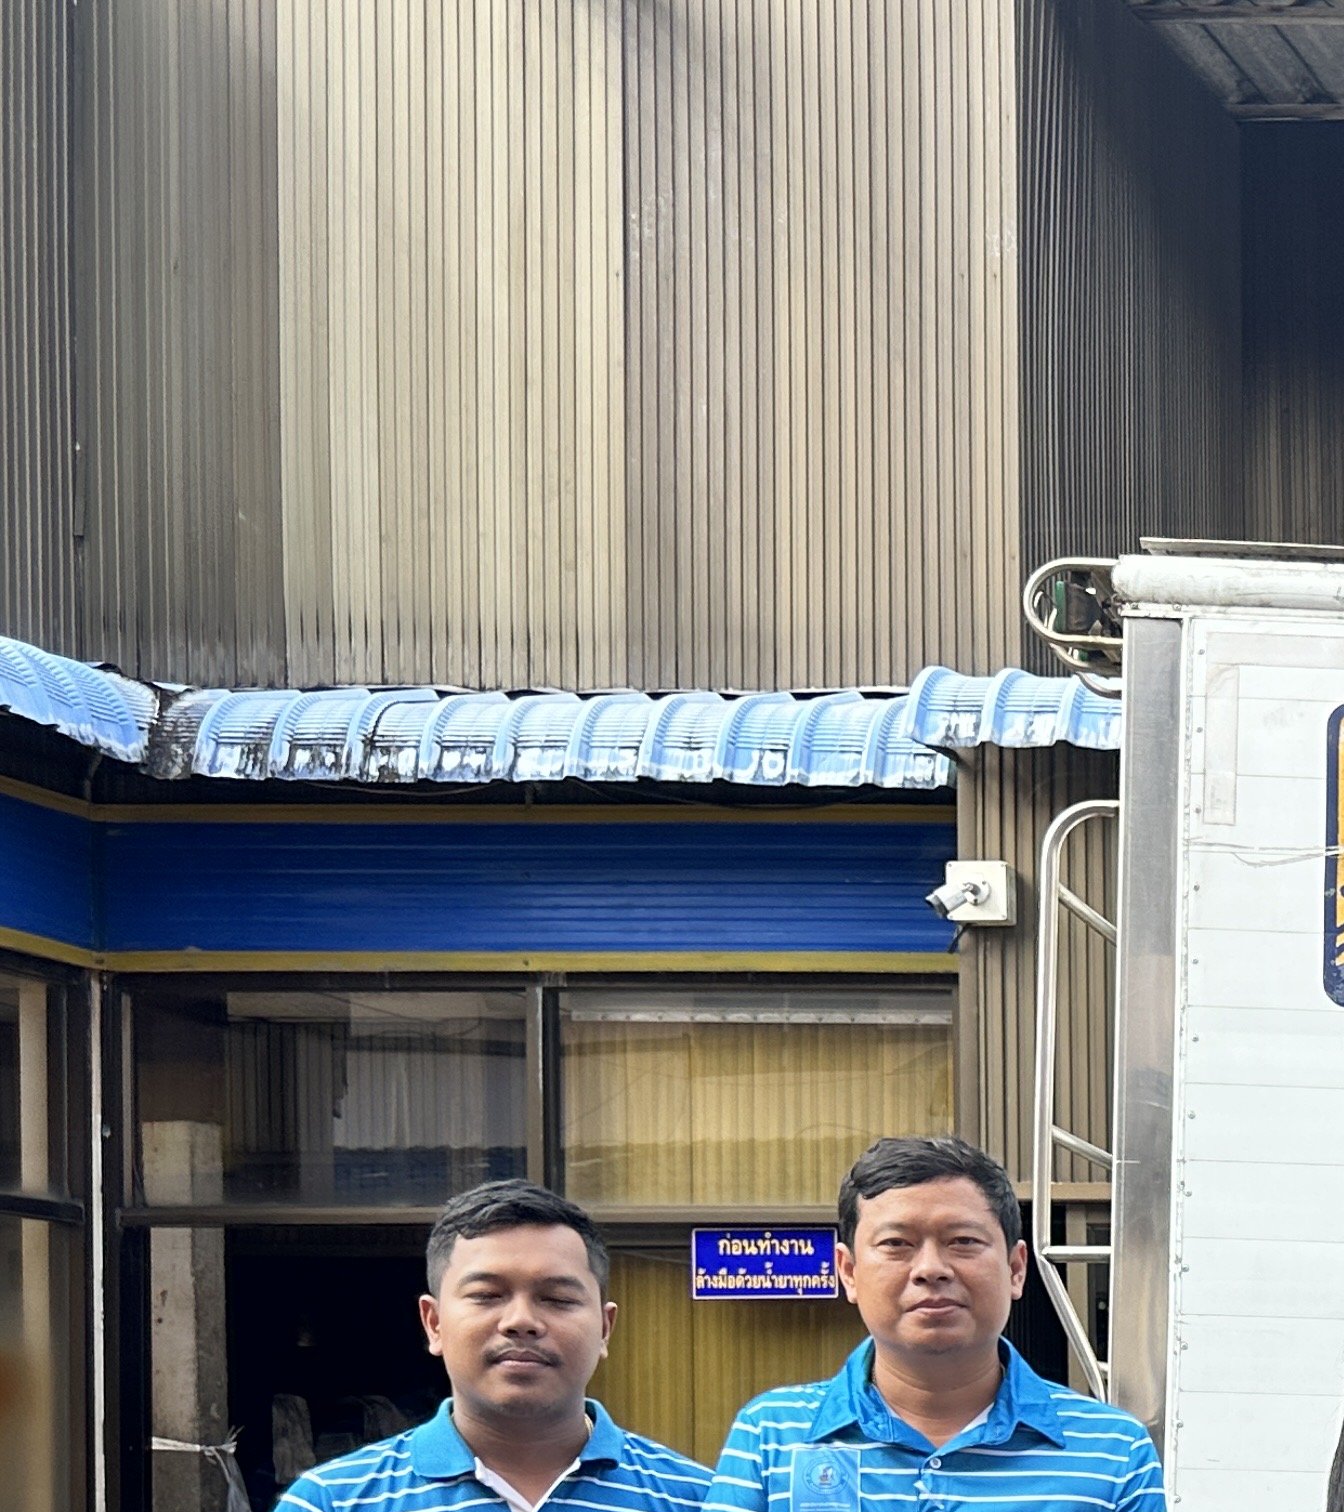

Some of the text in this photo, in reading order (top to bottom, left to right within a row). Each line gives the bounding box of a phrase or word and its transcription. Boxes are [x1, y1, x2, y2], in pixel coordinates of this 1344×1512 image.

[718, 1232, 815, 1256] ก่อนทำงาน
[696, 1261, 836, 1295] ล้างมือด้วยน้ำยาทุกครั้ง
